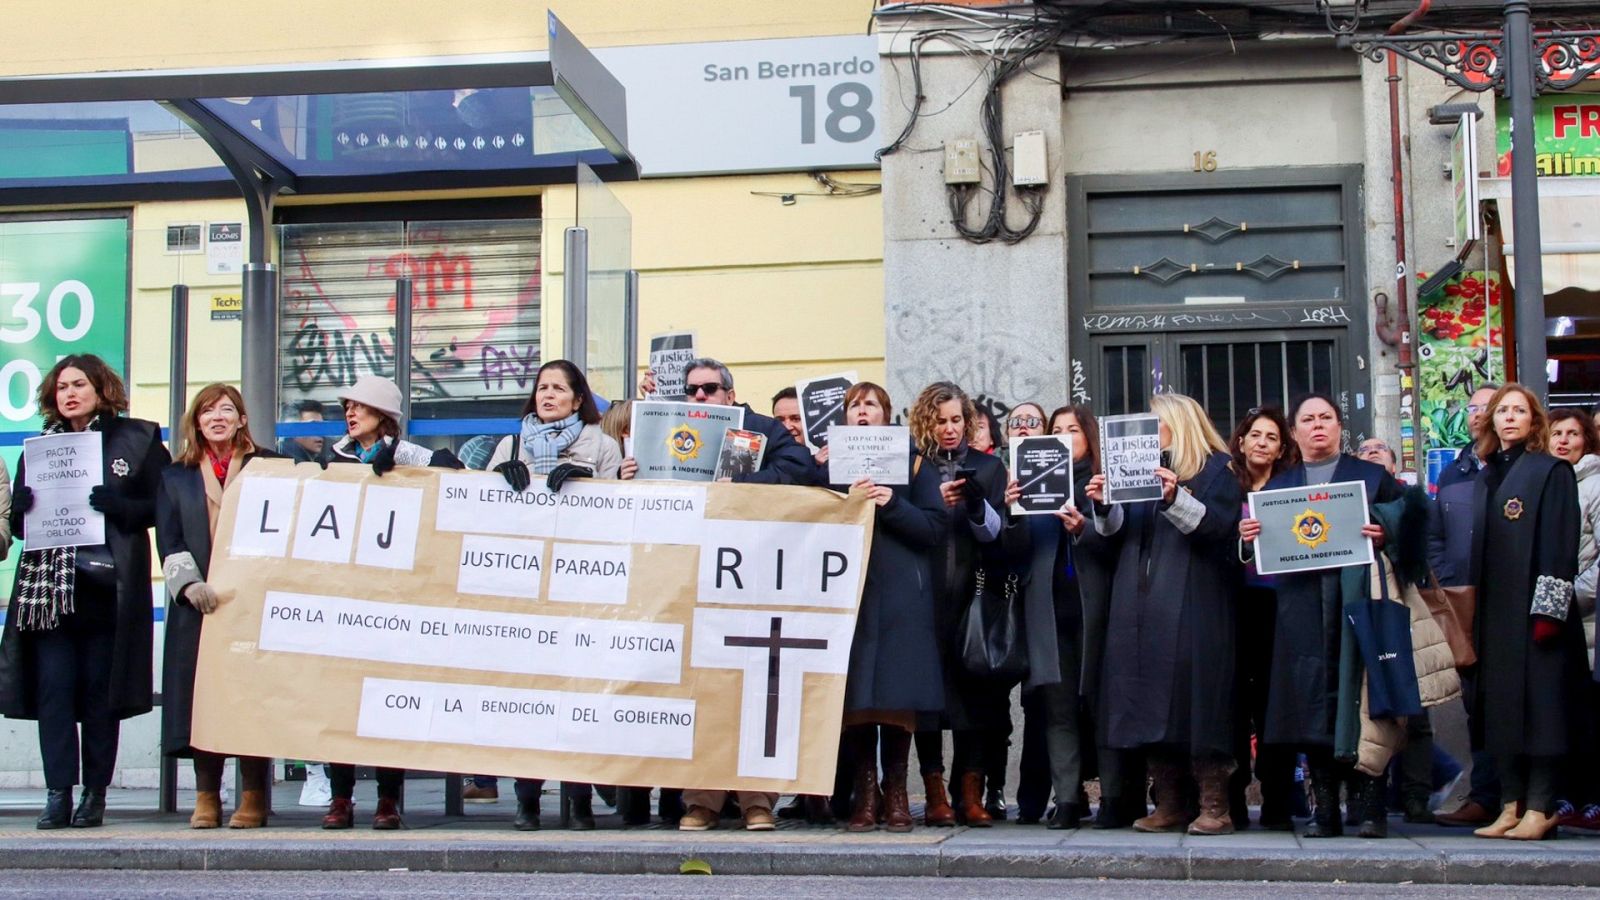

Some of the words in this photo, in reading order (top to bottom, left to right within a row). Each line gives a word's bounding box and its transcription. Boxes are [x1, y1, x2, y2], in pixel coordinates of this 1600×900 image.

[703, 63, 749, 82] San
[757, 55, 876, 80] Bernardo
[789, 81, 876, 145] 18
[1193, 150, 1218, 172] 16
[212, 232, 239, 241] LOOMIS
[660, 350, 694, 364] justicia
[860, 435, 894, 443] PACTADO
[1107, 439, 1119, 452] La
[1122, 435, 1160, 453] justicia
[46, 446, 77, 458] PACTA
[1131, 450, 1160, 464] PARADA
[48, 458, 75, 469] SUNT
[37, 469, 89, 482] SERVANDA
[678, 467, 716, 476] INDEFINID
[1120, 464, 1155, 477] Sanche
[1110, 480, 1121, 489] No
[1122, 478, 1143, 488] hace
[1143, 476, 1161, 486] nada
[445, 486, 468, 501] SIN
[478, 488, 557, 507] LETRADOS
[560, 494, 615, 510] ADMON
[618, 497, 634, 511] DE
[641, 497, 694, 513] JUSTICIA
[1262, 498, 1290, 507] JUSTICIA
[55, 507, 70, 517] LO
[42, 517, 86, 528] PACTADO
[46, 527, 82, 538] OBLIGA
[1279, 553, 1310, 563] HUELGA
[1311, 549, 1354, 560] INDEFINIDA
[461, 550, 541, 572] JUSTICIA
[555, 557, 627, 578] PARADA
[270, 605, 301, 621] POR
[306, 608, 324, 624] LA
[337, 610, 411, 632] INACCIÓN
[420, 620, 449, 637] DEL
[453, 621, 532, 640] MINISTERIO
[537, 629, 559, 646] DE
[574, 632, 597, 649] IN-
[609, 634, 676, 654] JUSTICIA
[384, 693, 422, 711] CON
[443, 697, 463, 714] LA
[480, 698, 556, 717] BENDICIÓN
[571, 706, 600, 724] DEL
[613, 708, 693, 728] GOBIERNO
